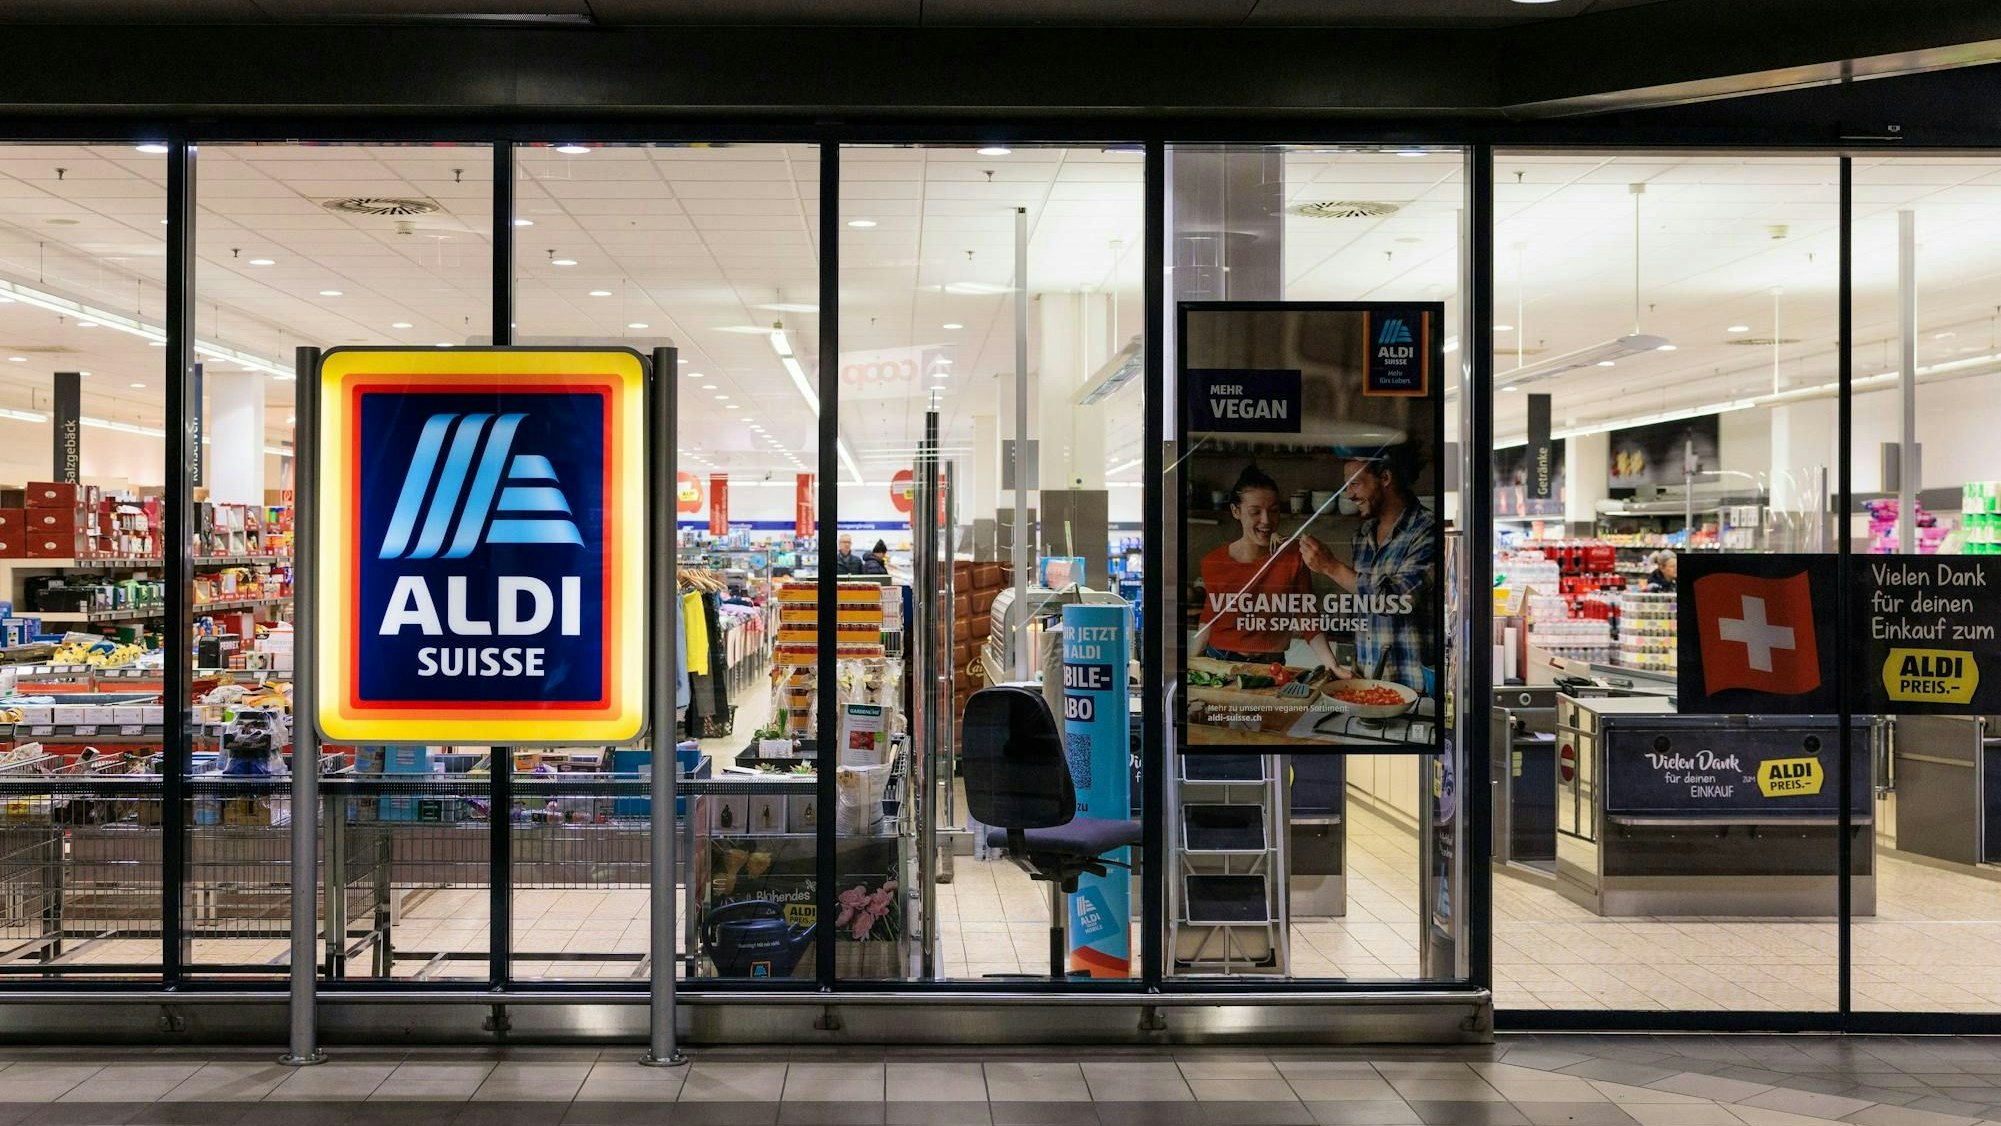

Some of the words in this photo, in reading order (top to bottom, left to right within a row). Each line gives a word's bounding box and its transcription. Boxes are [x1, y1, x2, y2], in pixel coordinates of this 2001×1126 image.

[1378, 346, 1414, 358] ALDI
[1210, 385, 1243, 395] MEHR
[1210, 399, 1287, 419] VEGAN
[64, 419, 78, 484] Salzgebäck
[1537, 447, 1549, 495] Getränke
[1871, 563, 1930, 586] Vielen
[1938, 563, 1987, 586] Dank
[379, 575, 581, 636] ALDI
[1209, 593, 1317, 613] VEGANER
[1323, 593, 1413, 615] GENUSS
[1871, 590, 1904, 613] für
[1911, 590, 1973, 613] deinen
[1236, 614, 1266, 632] FÜR
[1270, 614, 1368, 632] SPARFÜCHSE
[1872, 616, 1947, 640] Einkauf
[1952, 625, 1995, 640] zum
[1078, 627, 1118, 643] JETZT
[417, 647, 545, 677] SUISSE
[1071, 645, 1101, 660] ALDI
[1900, 655, 1963, 679] ALDI
[1063, 666, 1110, 688] BILE-
[1207, 704, 1227, 712] Mehr
[1274, 705, 1309, 714] veganen
[1207, 713, 1263, 722] aldi-suisse.ch
[1644, 753, 1694, 770] Vielen
[1696, 750, 1743, 772] Dank
[1664, 772, 1681, 784] für
[1684, 771, 1716, 784] deinen
[1769, 763, 1812, 779] ALDI
[1690, 785, 1735, 798] EINKAUF
[790, 907, 816, 917] ALDI
[1081, 912, 1101, 927] ALDI
